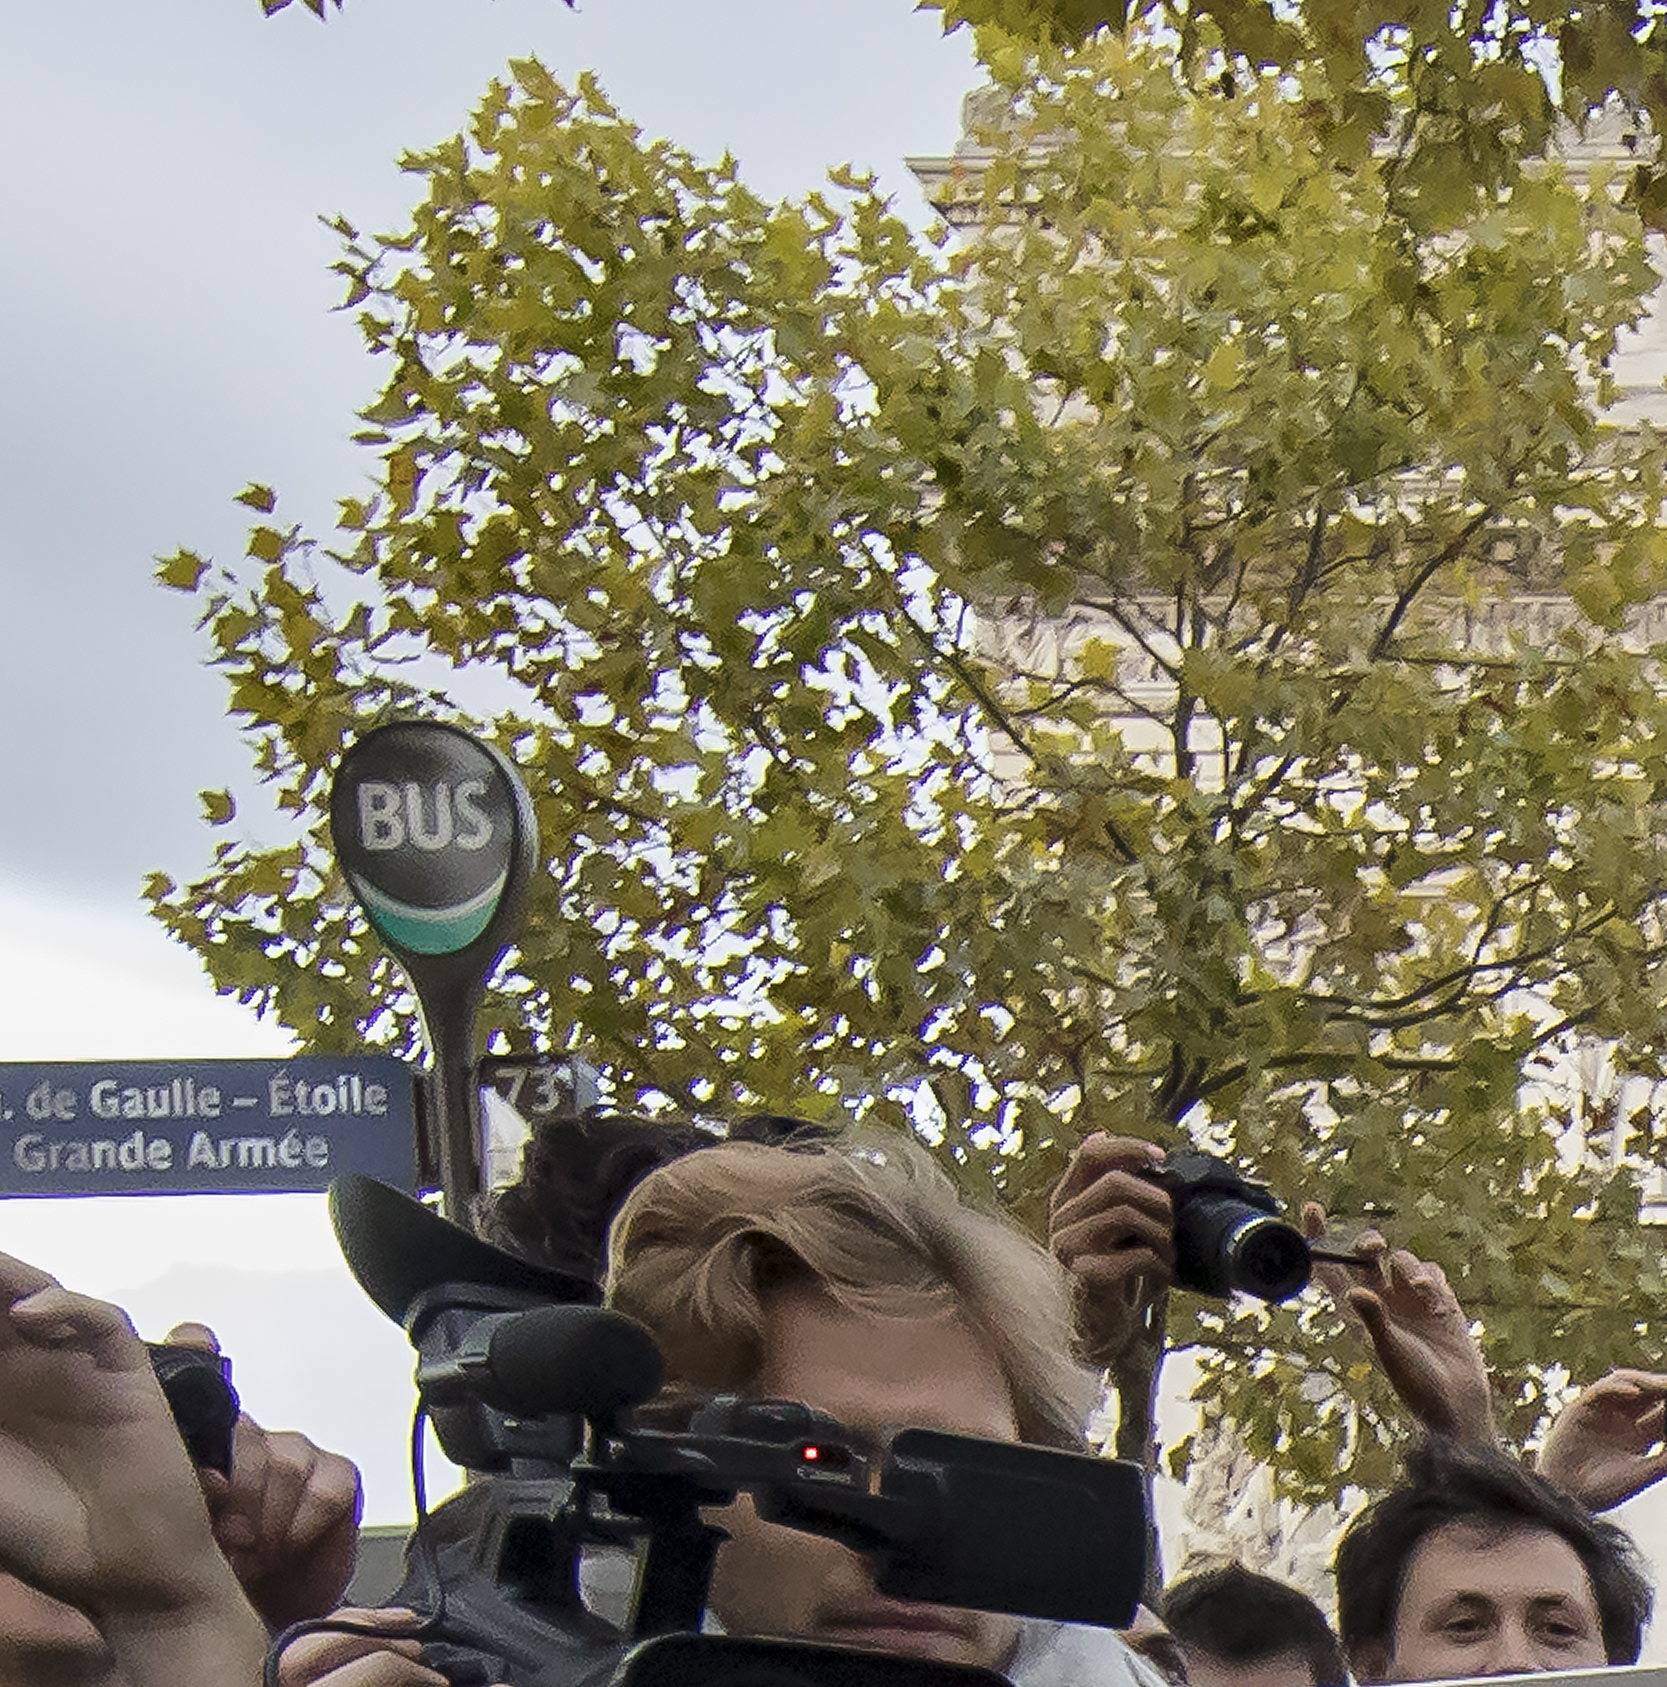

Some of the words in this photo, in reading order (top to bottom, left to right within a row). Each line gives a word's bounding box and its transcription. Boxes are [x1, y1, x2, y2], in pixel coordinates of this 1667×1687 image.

[358, 779, 493, 851] BUS
[26, 1079, 77, 1121] de
[90, 1077, 221, 1120] Gaulle
[269, 1070, 389, 1118] Étoile
[14, 1131, 173, 1172] Grande
[188, 1126, 330, 1170] Armée
